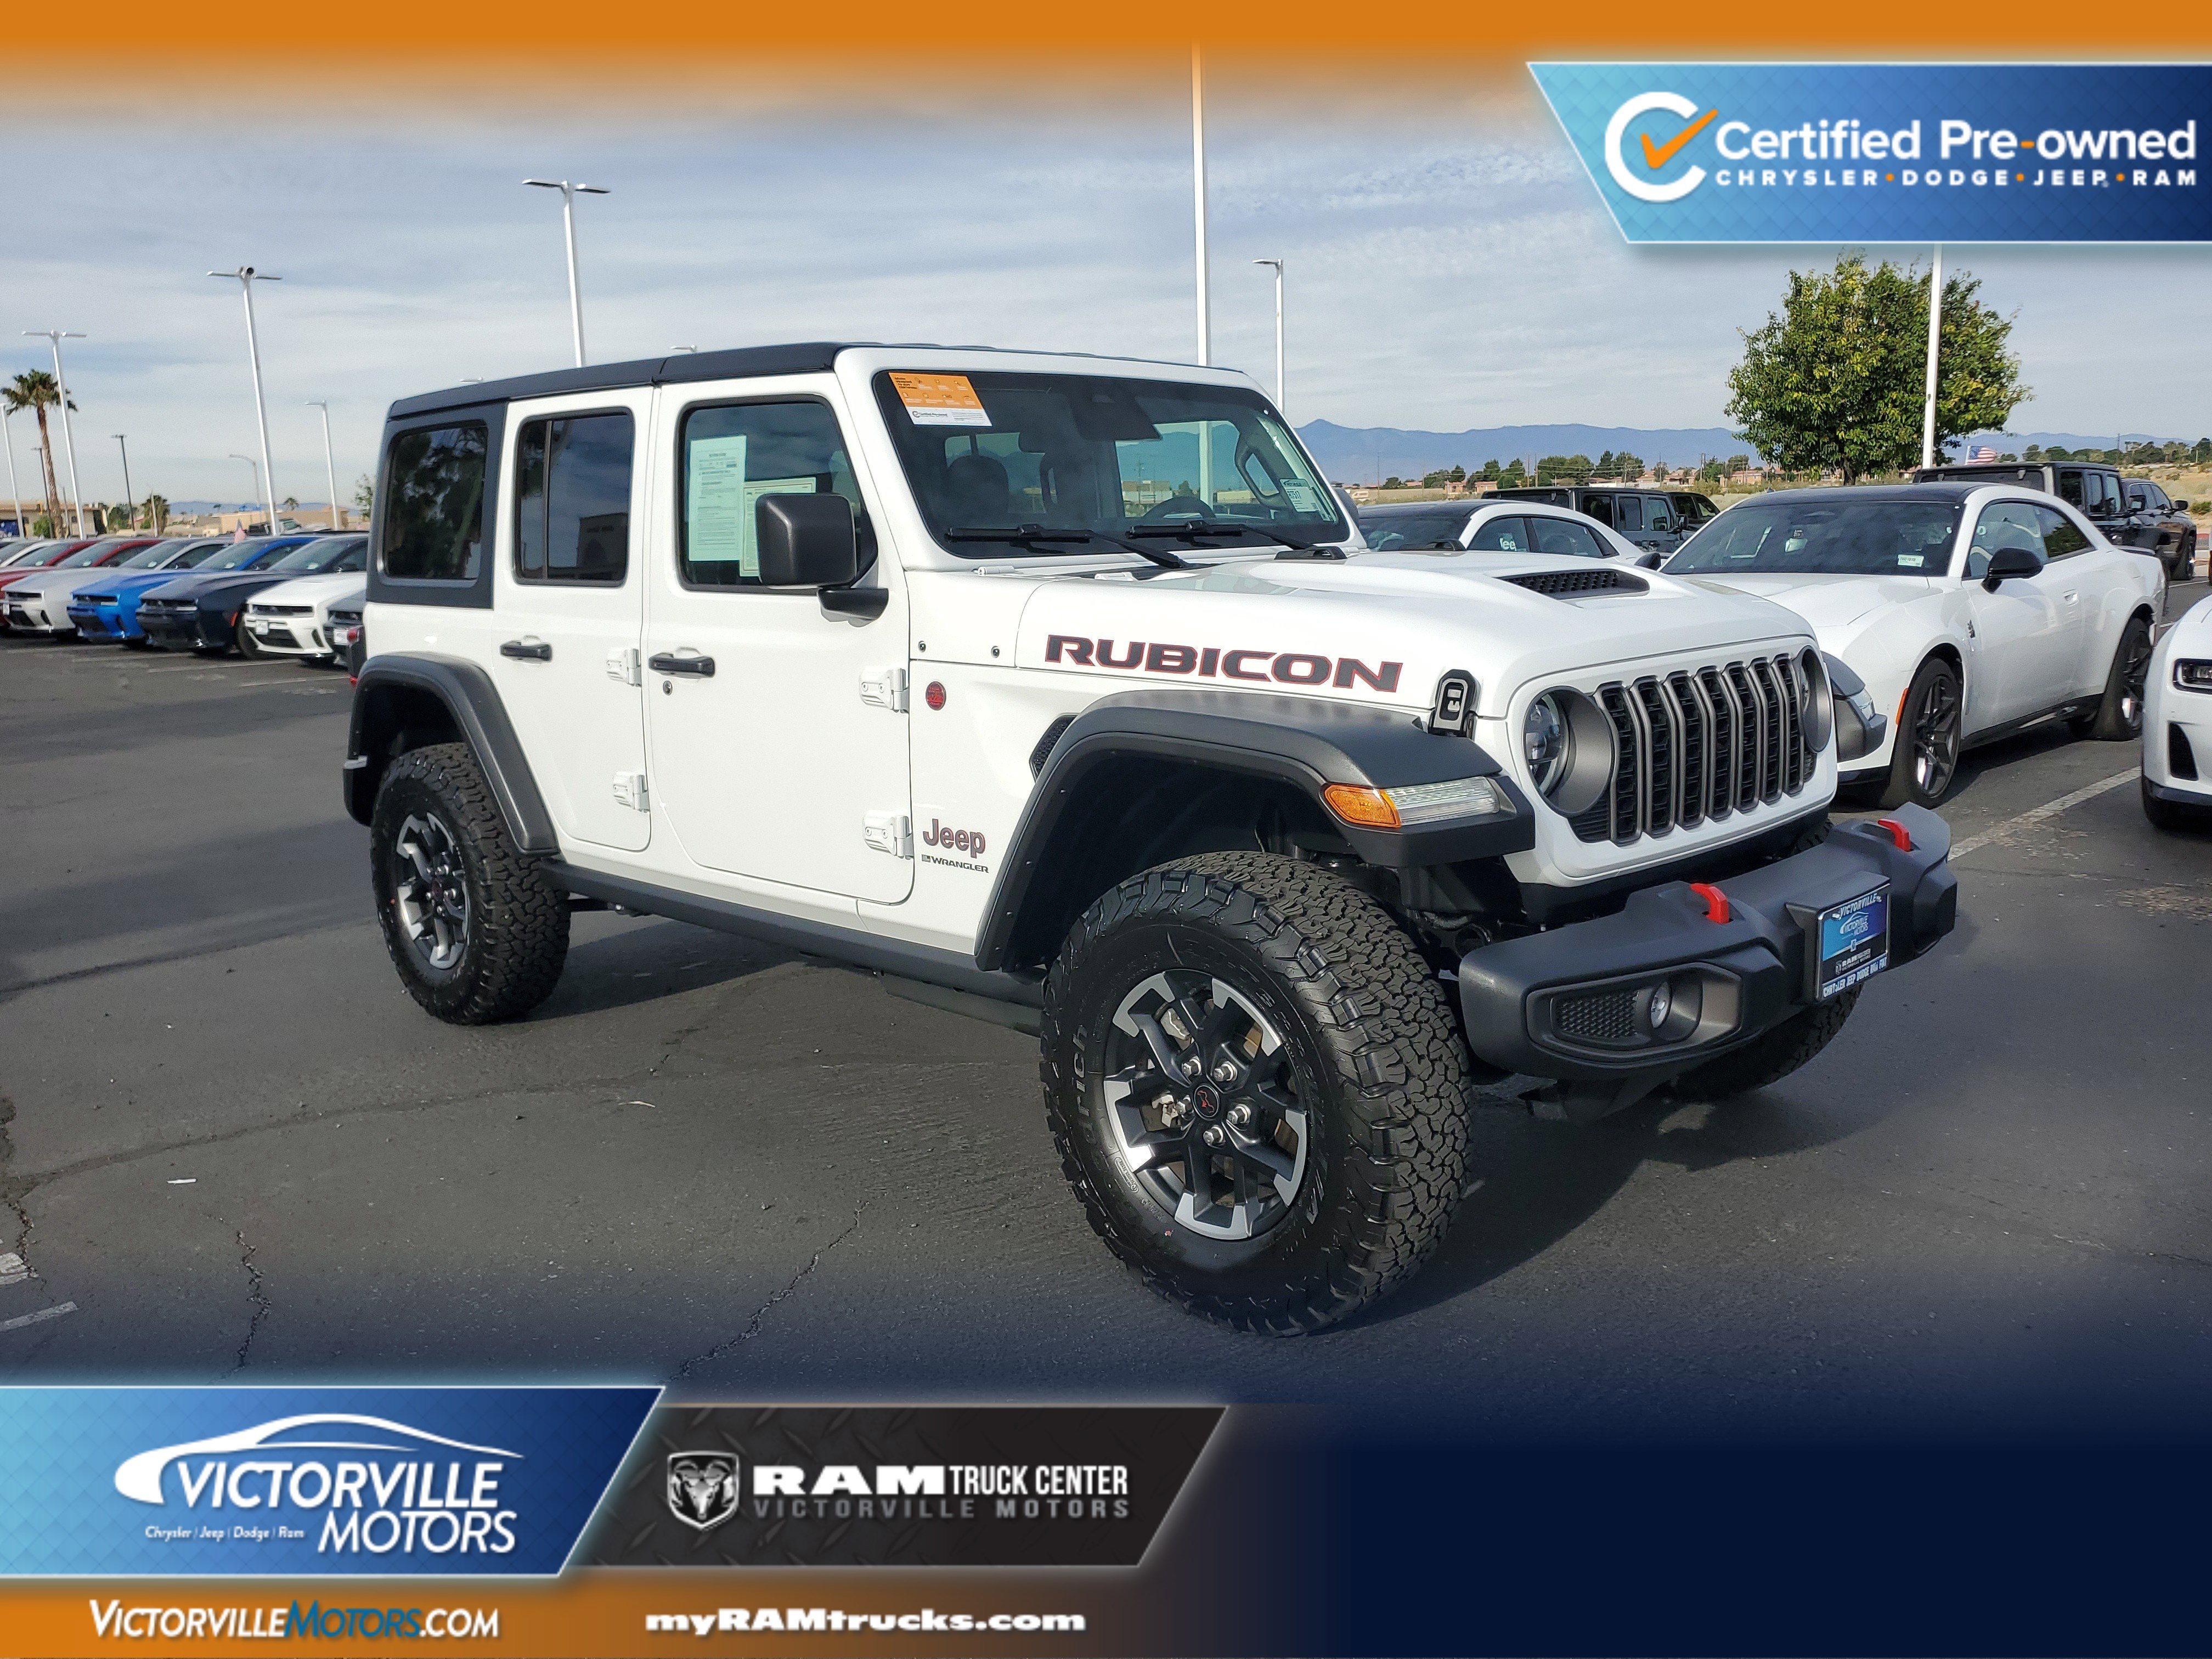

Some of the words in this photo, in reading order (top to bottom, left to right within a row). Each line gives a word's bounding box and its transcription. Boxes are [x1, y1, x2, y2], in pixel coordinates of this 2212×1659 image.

[1045, 634, 1403, 693] RUBICON
[923, 819, 986, 859] Jeep
[930, 856, 989, 873] WRANGLER
[1840, 893, 1877, 917] VICTORVILLE
